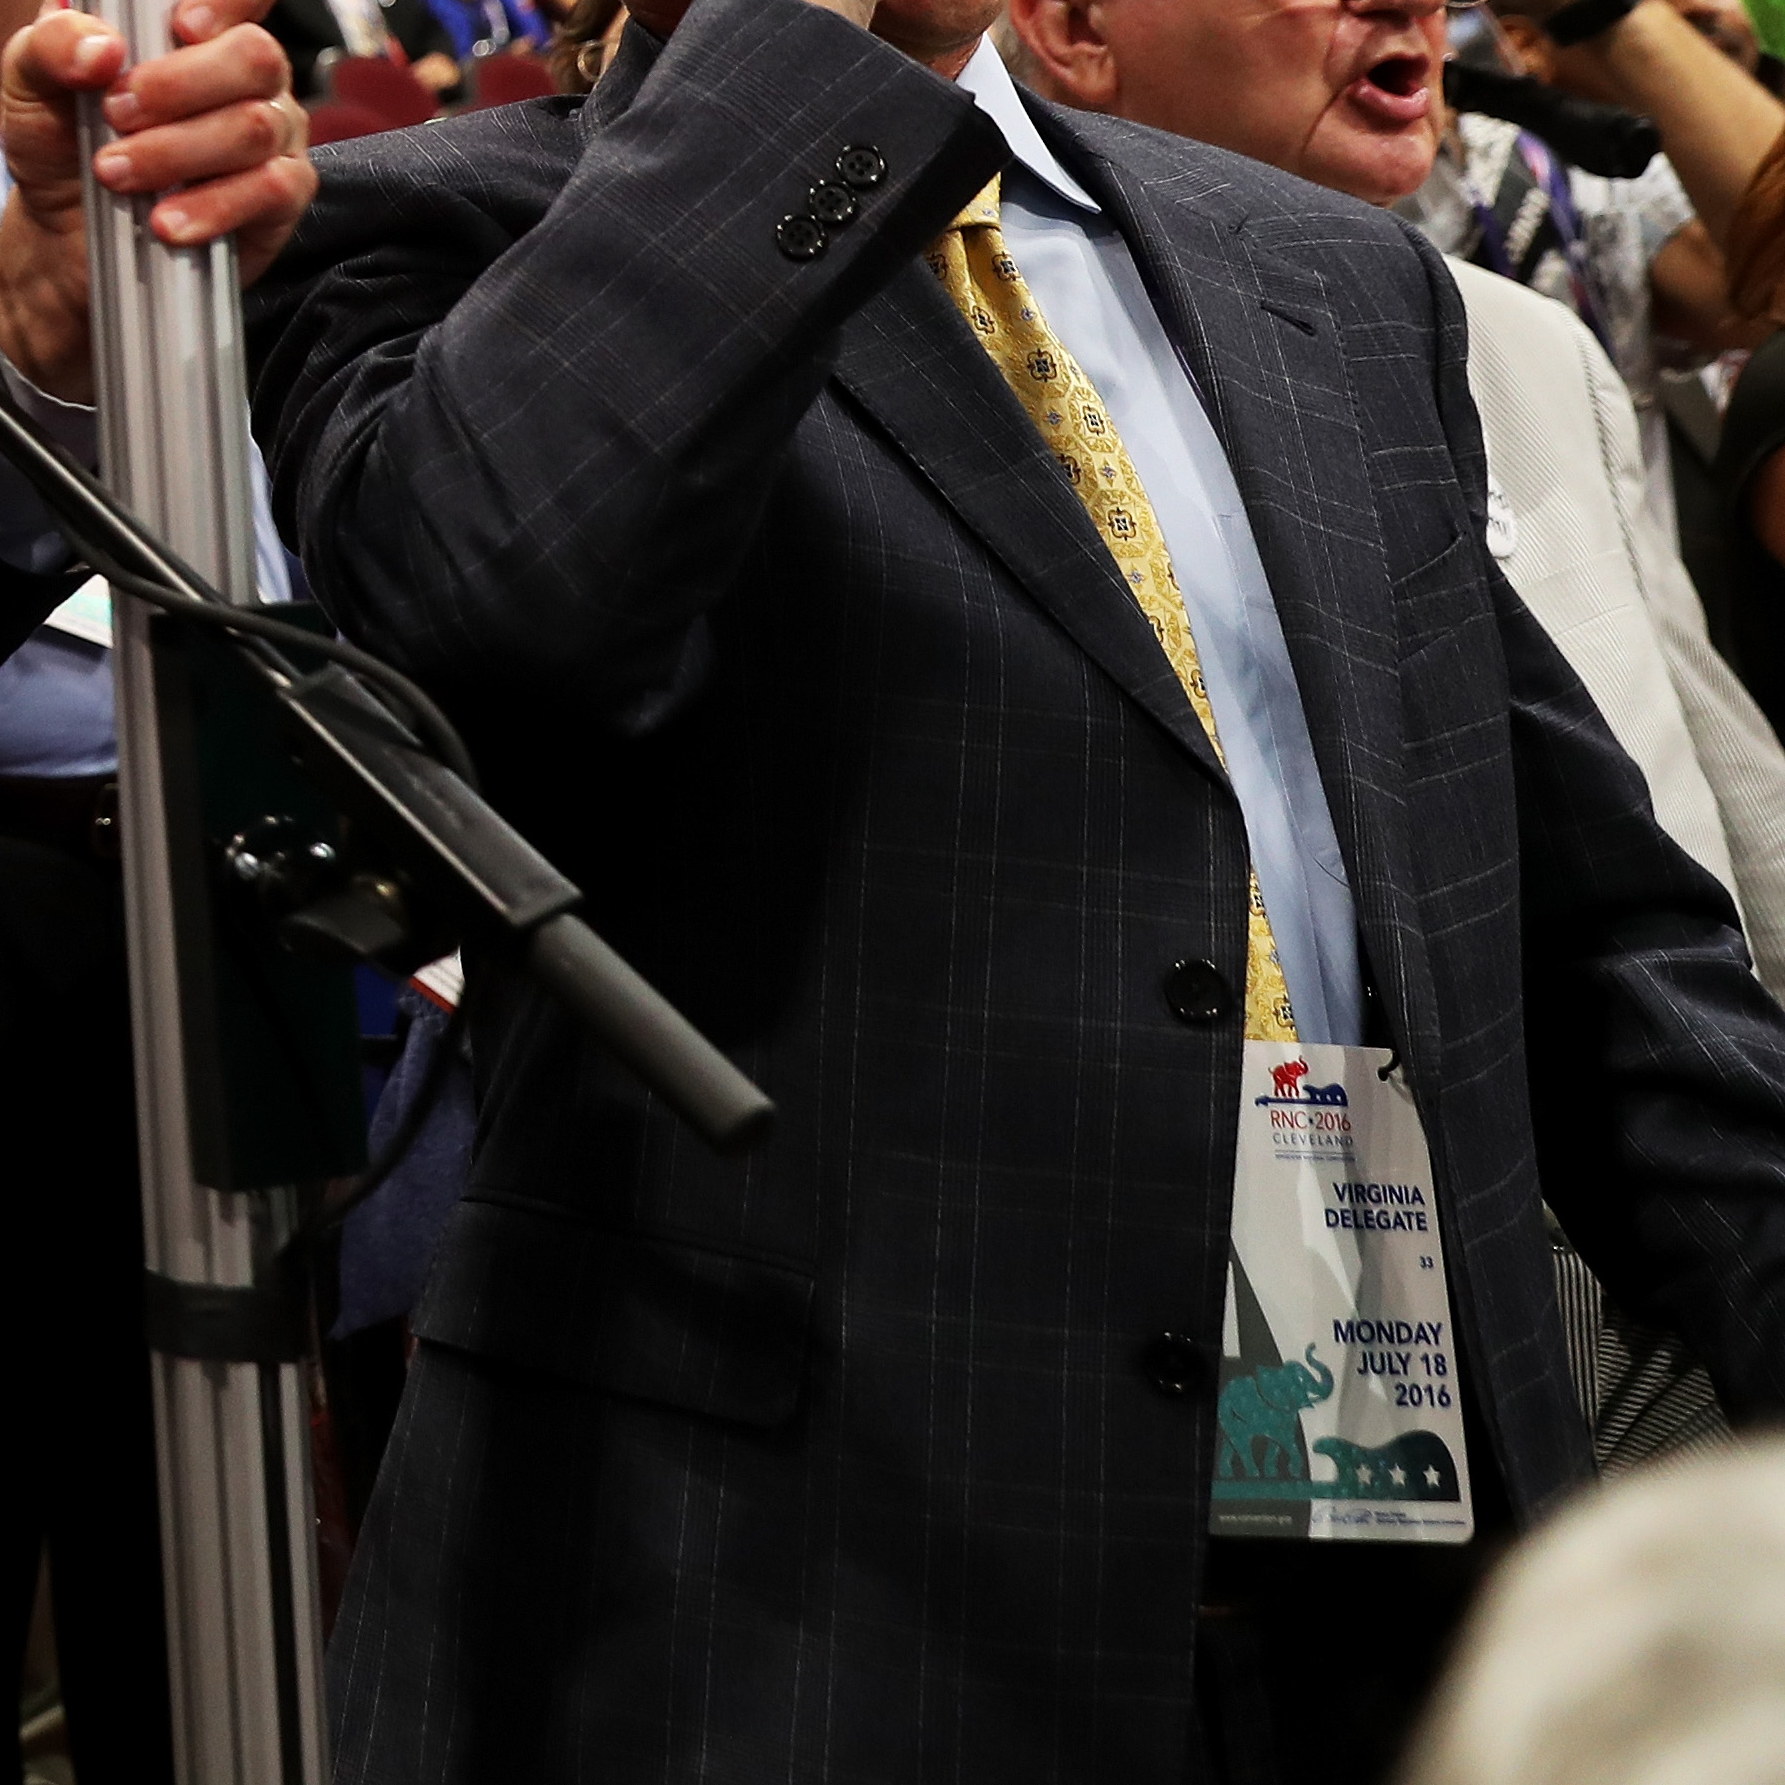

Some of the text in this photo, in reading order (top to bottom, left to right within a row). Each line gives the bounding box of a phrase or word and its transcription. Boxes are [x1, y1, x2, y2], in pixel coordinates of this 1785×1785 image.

[1272, 1131, 1355, 1148] CLEVELAND
[1332, 1181, 1426, 1207] VIRGINIA
[1324, 1207, 1429, 1232] DELEGATE
[1332, 1318, 1443, 1347] MONDAY
[1356, 1351, 1448, 1378] JULY 18
[1394, 1382, 1453, 1410] 2016
